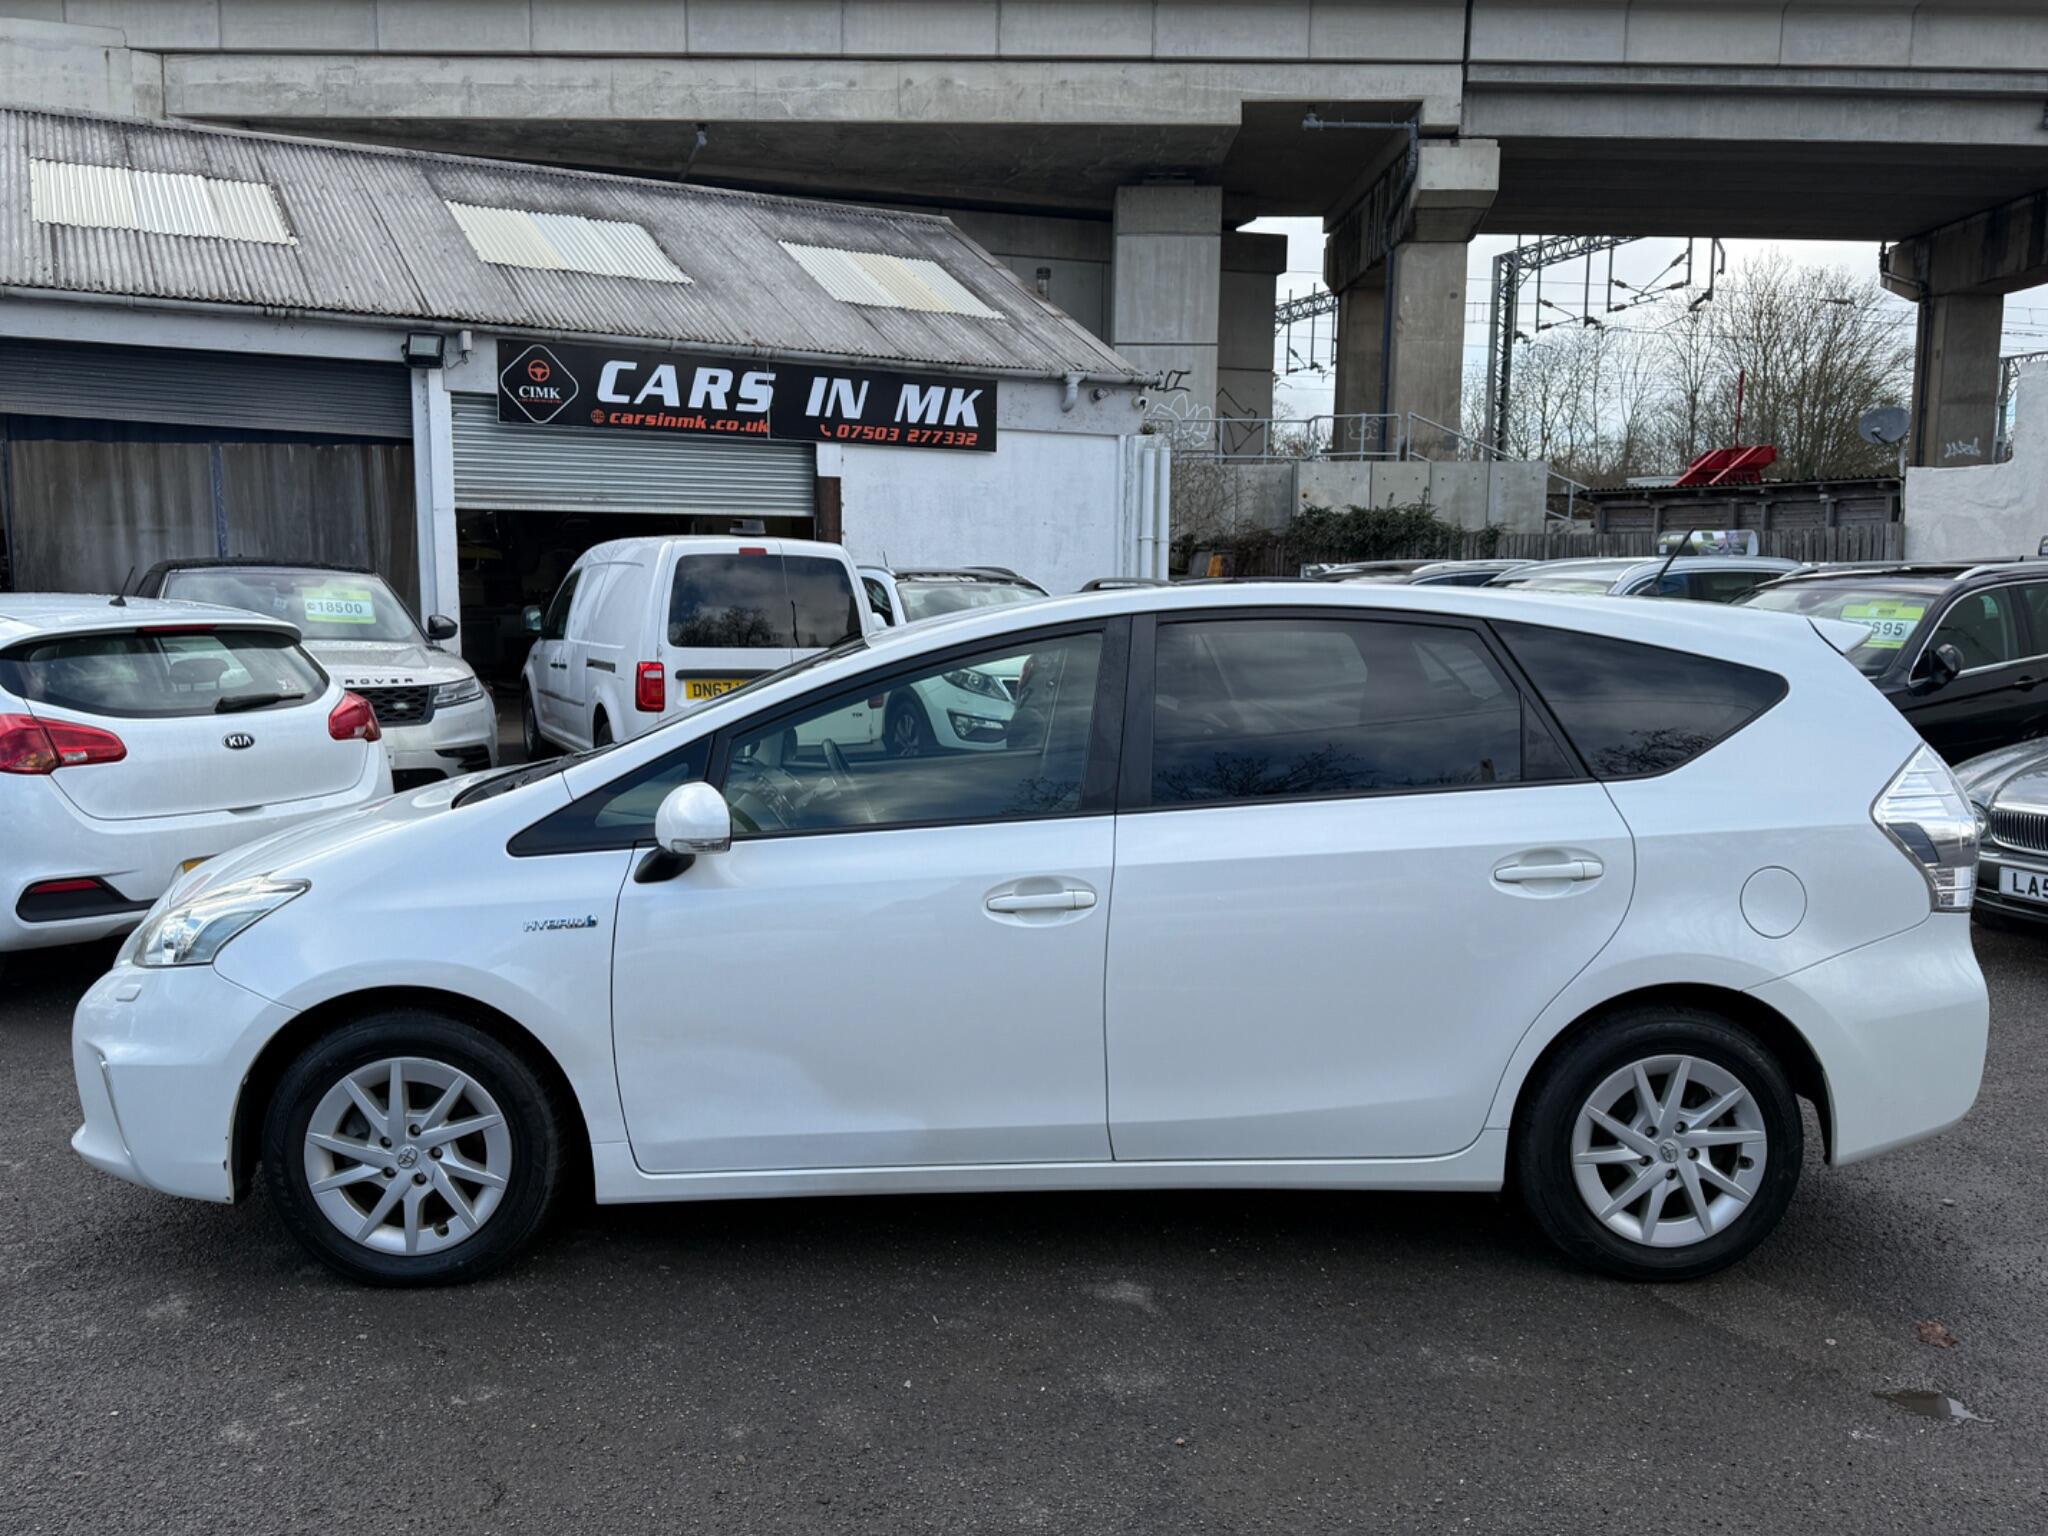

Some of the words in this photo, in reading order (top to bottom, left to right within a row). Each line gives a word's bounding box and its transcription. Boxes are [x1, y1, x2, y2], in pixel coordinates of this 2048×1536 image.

[518, 385, 561, 399] CIMK
[597, 360, 776, 413] CARS
[805, 376, 870, 419] IN
[894, 384, 983, 427] MK
[609, 412, 768, 433] carsinmk.co.uk
[836, 424, 900, 441] 07503
[907, 428, 978, 446] 277332
[229, 735, 252, 746] KIA
[523, 919, 586, 932] HYBRID
